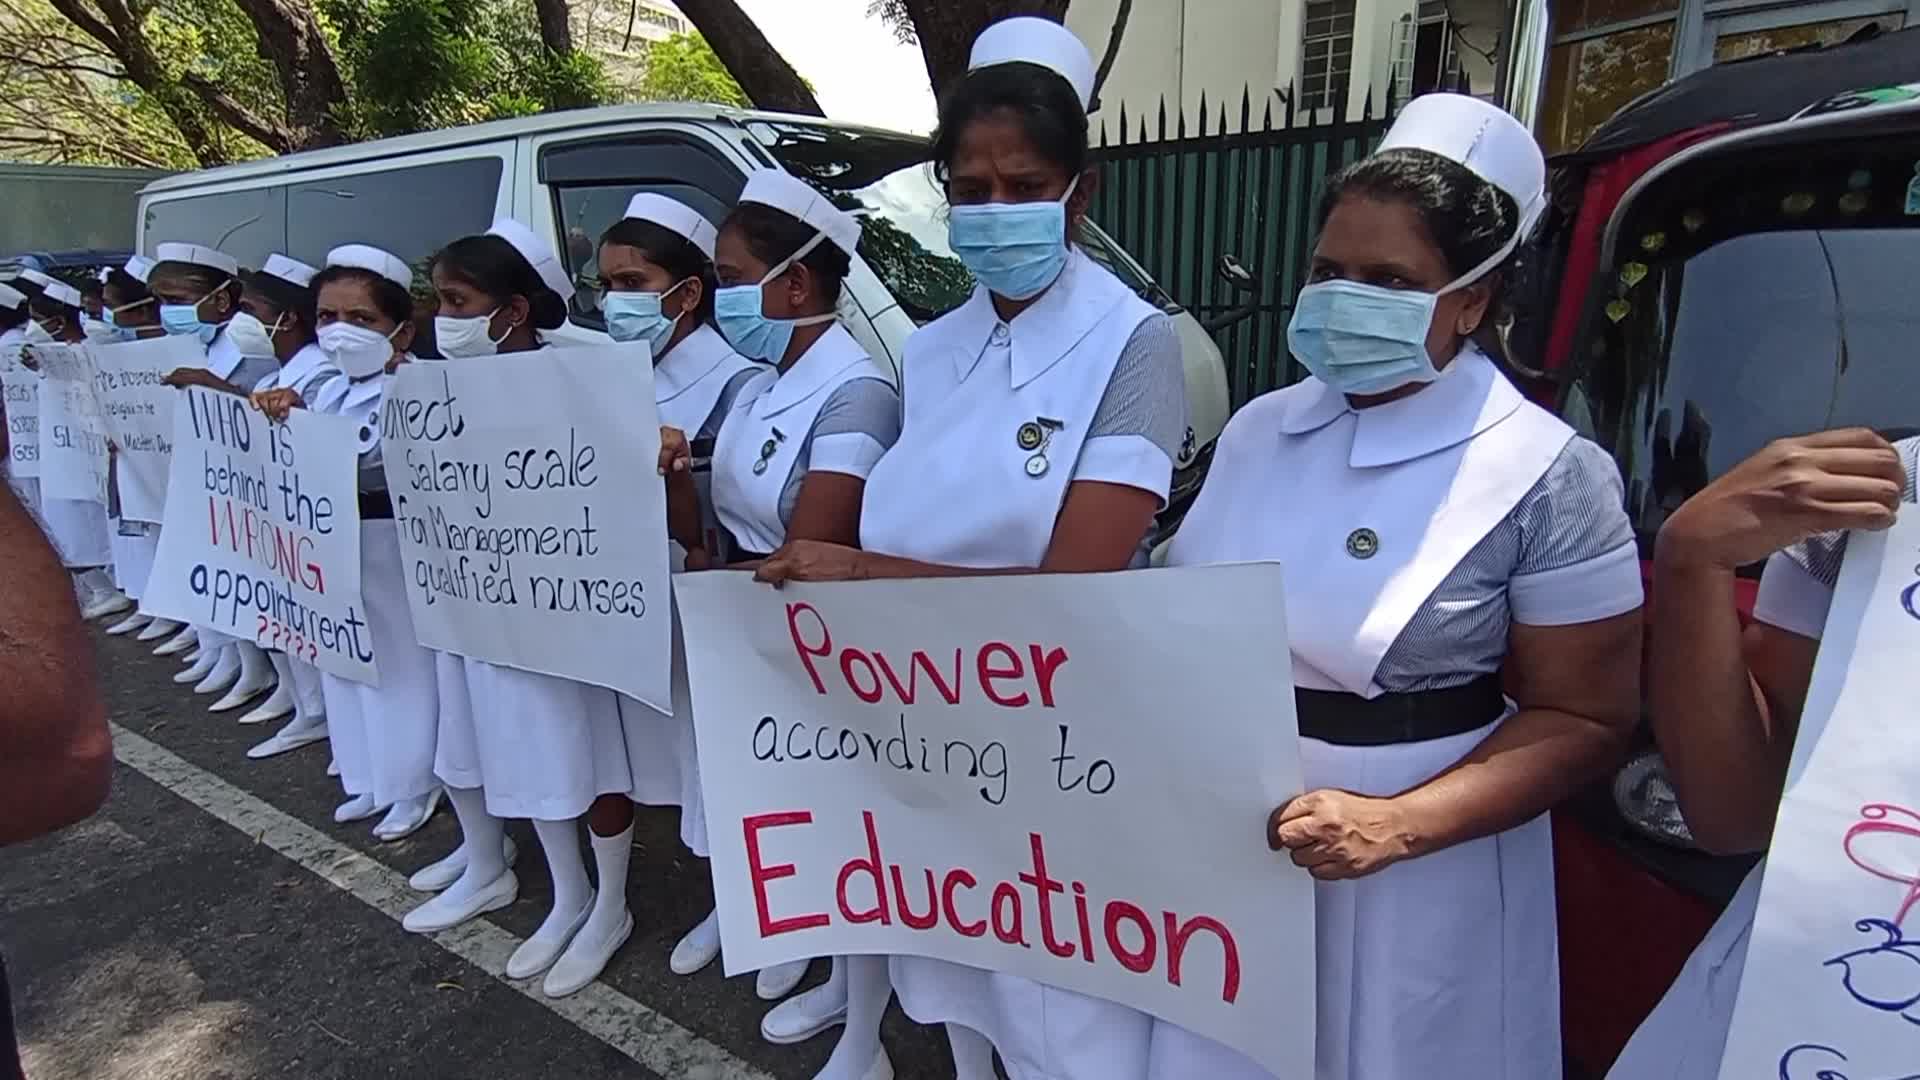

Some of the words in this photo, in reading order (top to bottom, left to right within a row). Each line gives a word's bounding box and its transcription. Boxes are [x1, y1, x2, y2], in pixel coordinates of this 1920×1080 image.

[187, 388, 251, 453] WHO
[268, 418, 295, 468] is
[504, 426, 599, 490] scale
[204, 450, 269, 513] behind
[278, 469, 333, 535] the
[209, 495, 325, 594] WRONG
[426, 504, 599, 573] Management
[189, 563, 374, 663] appointment
[415, 555, 518, 606] qualified
[529, 575, 646, 619] nurses
[786, 601, 1069, 708] Power
[752, 713, 1008, 805] according
[1051, 724, 1116, 796] to
[742, 810, 1241, 1005] Education
